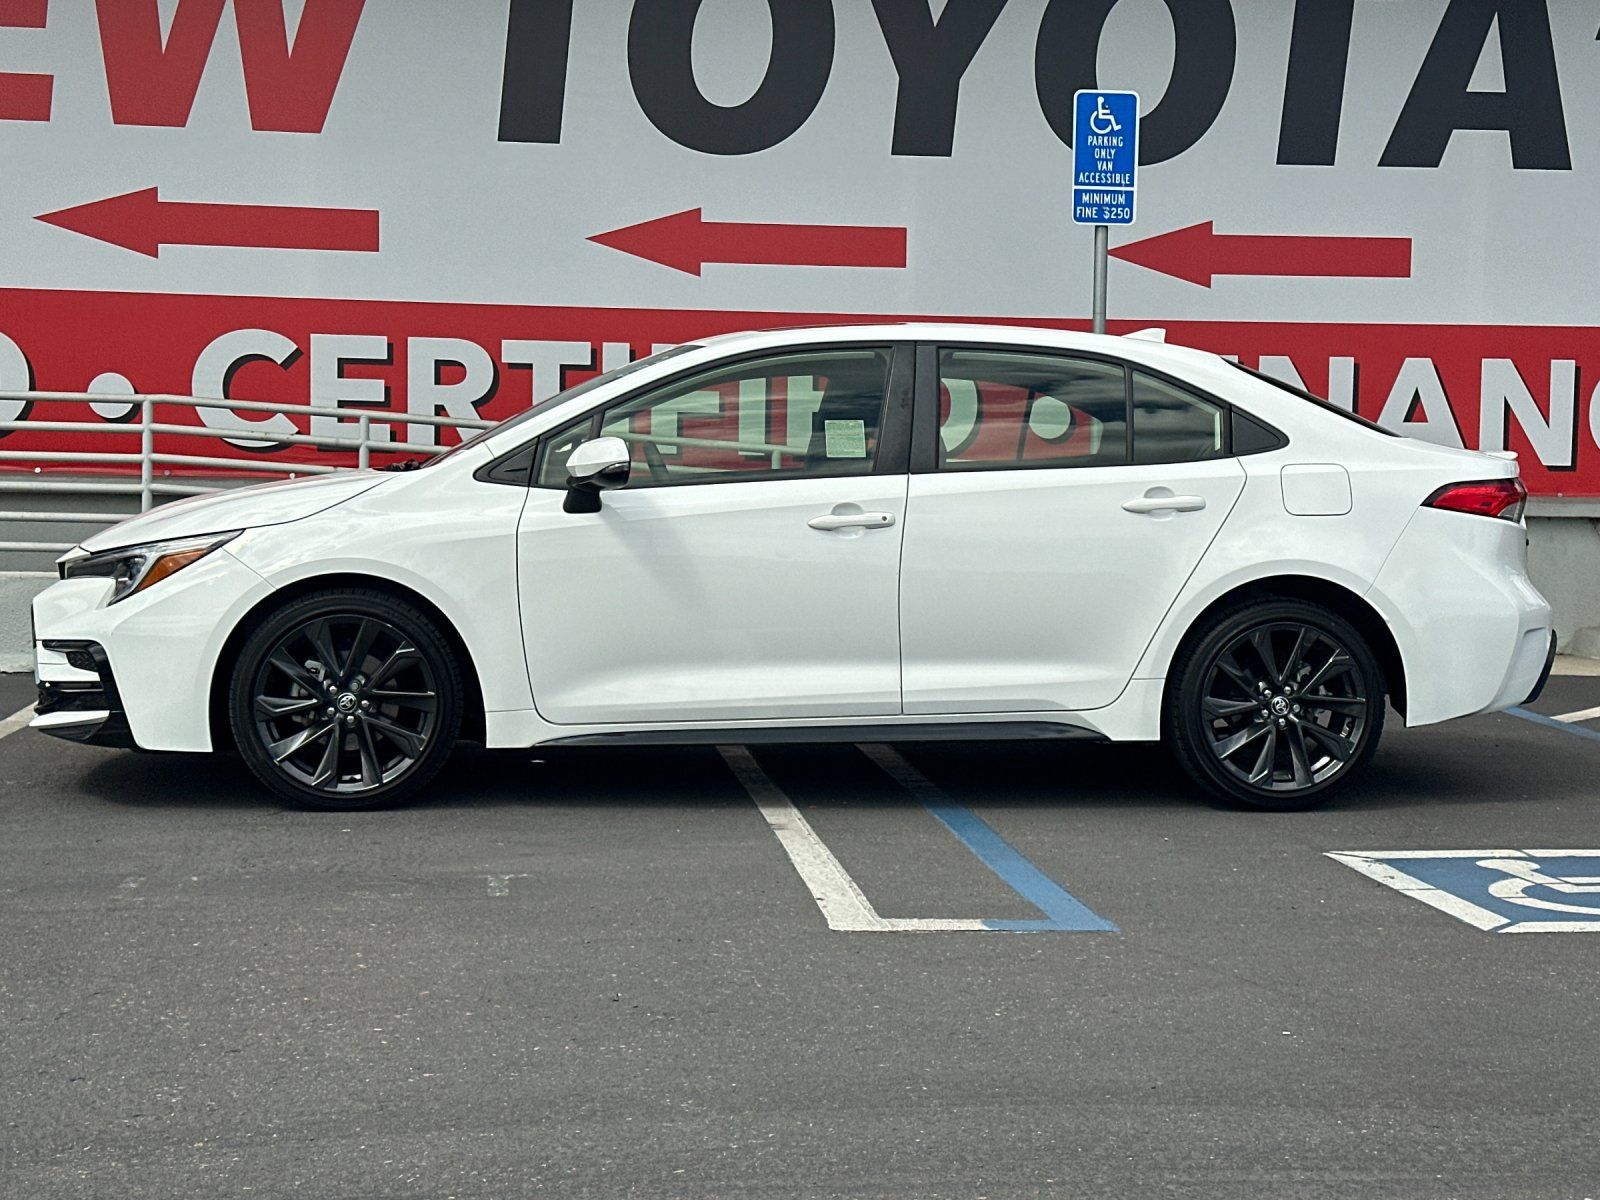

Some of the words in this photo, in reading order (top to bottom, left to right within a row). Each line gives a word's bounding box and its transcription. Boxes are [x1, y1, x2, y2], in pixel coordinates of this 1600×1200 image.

[0, 0, 366, 133] W
[1087, 135, 1124, 147] PARKING
[1094, 148, 1116, 159] ONLY
[1097, 161, 1113, 172] VAN
[1078, 172, 1131, 184] ACCESSIBLE
[1082, 192, 1126, 205] MINIMUM
[1076, 206, 1098, 218] FINE
[1103, 206, 1131, 219] $250
